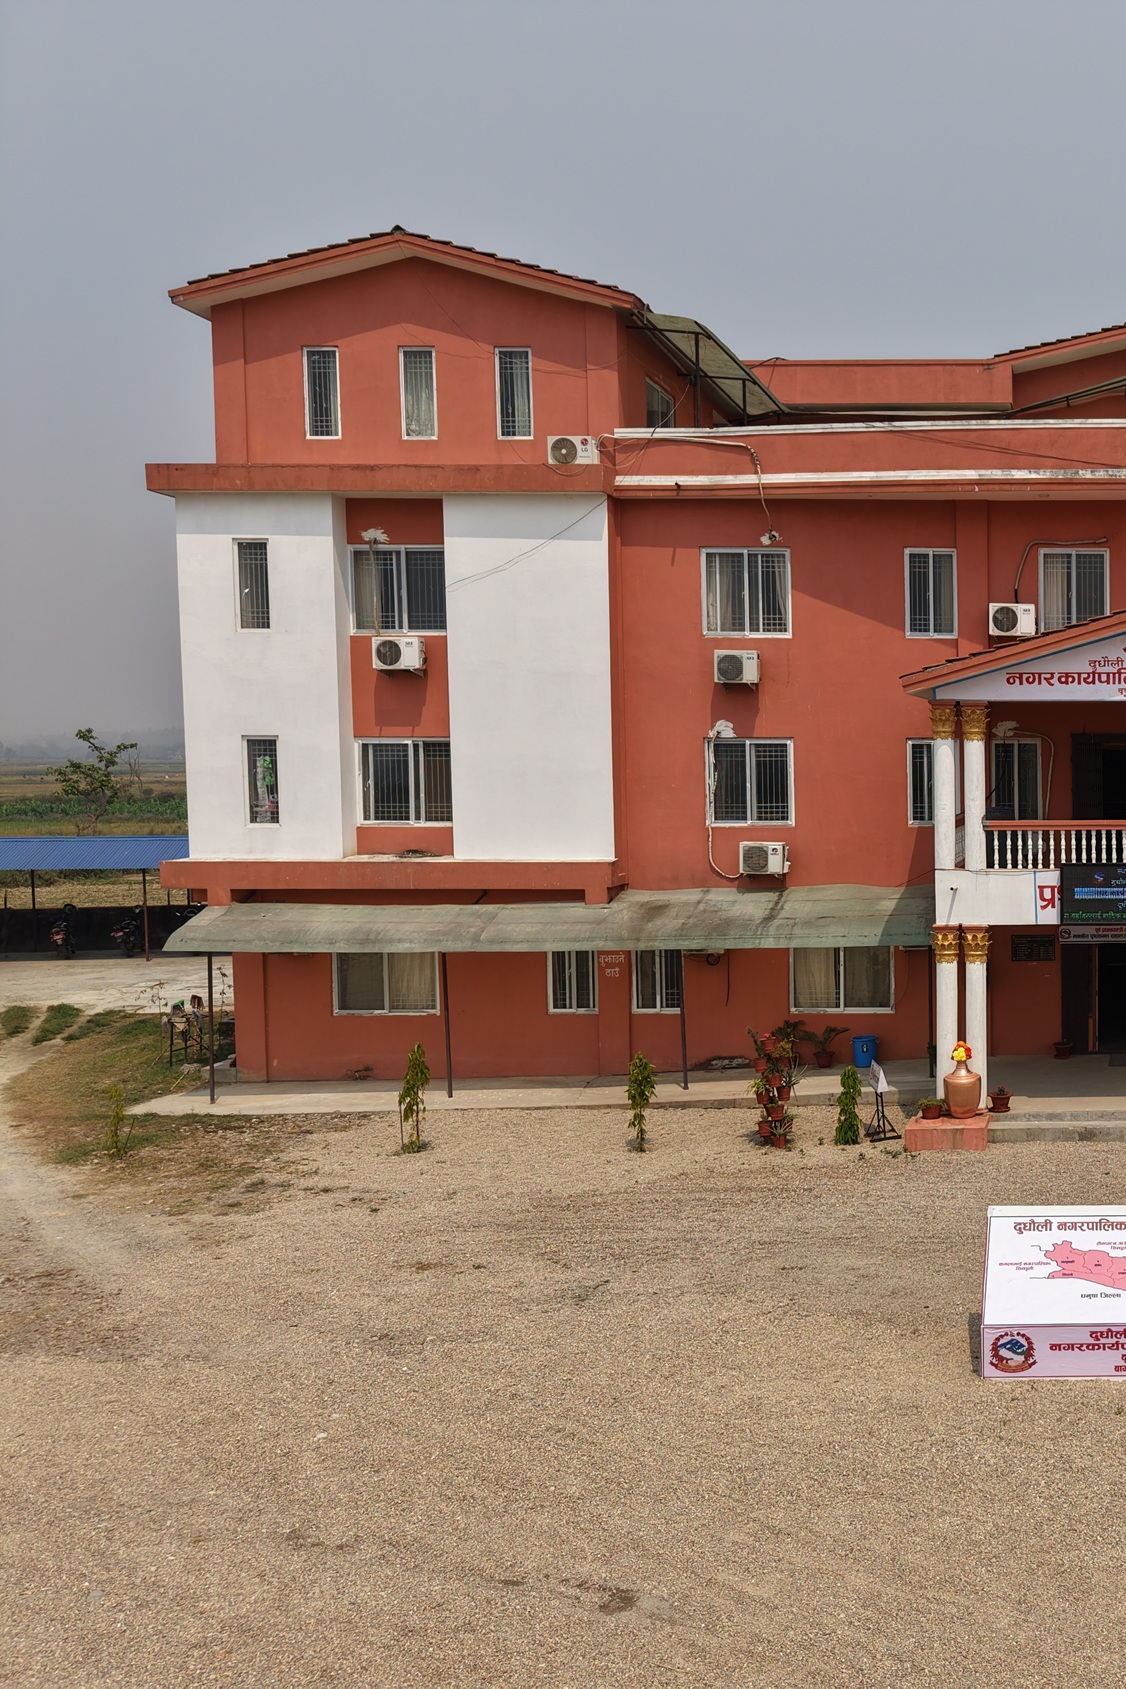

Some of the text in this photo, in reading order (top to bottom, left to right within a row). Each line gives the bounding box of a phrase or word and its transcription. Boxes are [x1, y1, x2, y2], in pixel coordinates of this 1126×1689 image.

[1088, 656, 1124, 672] दुधौली
[1006, 671, 1056, 686] नगर
[1013, 1219, 1053, 1234] दुधौली
